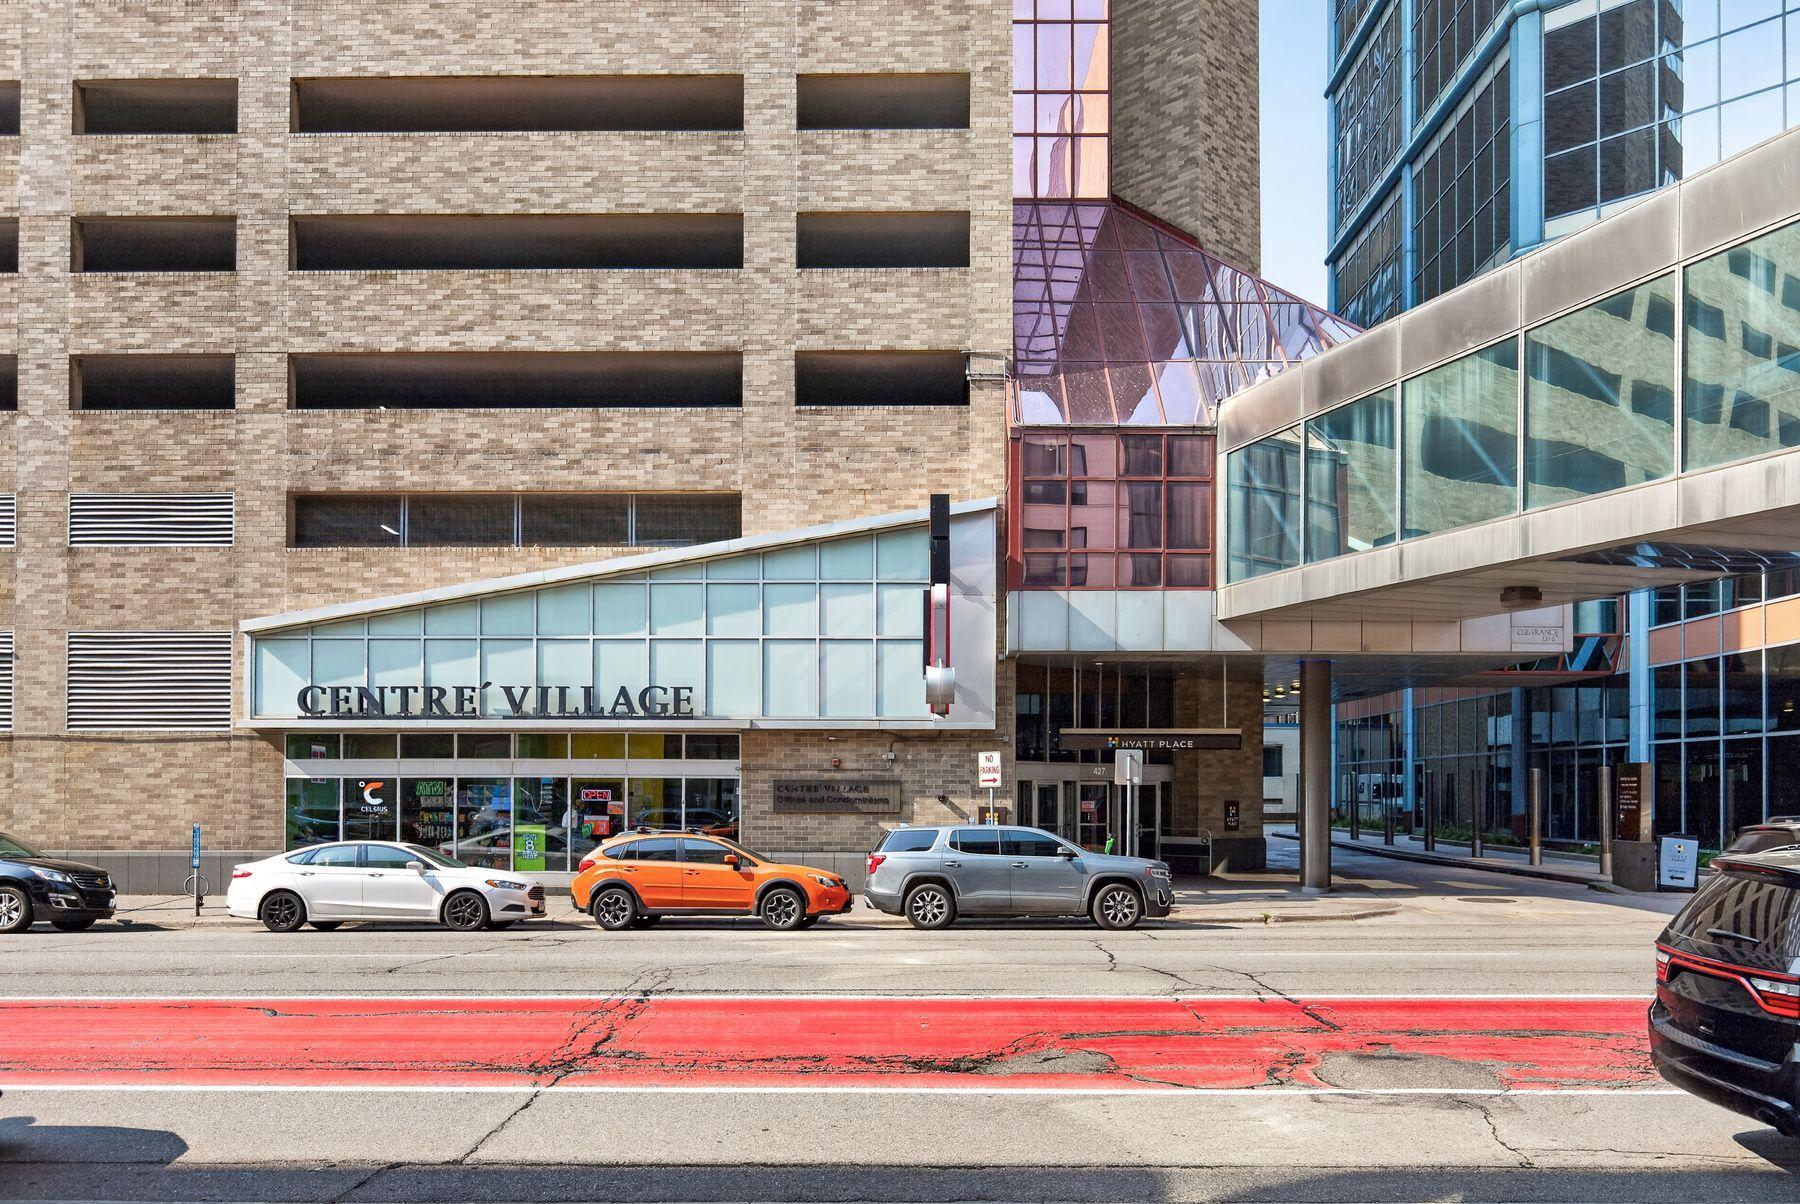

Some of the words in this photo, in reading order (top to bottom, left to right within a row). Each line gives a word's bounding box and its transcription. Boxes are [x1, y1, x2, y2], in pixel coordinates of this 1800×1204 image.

[1516, 628, 1559, 637] CLEARANCE
[500, 684, 693, 715] VILLAGE
[1121, 740, 1155, 748] HYATT
[1159, 740, 1194, 748] PLACE
[984, 754, 994, 763] NO
[980, 765, 1000, 774] PARKING
[1093, 767, 1106, 776] 427
[416, 781, 444, 796] ATM
[824, 785, 870, 794] VILLAGE
[583, 790, 610, 800] OPEN
[808, 795, 825, 804] and
